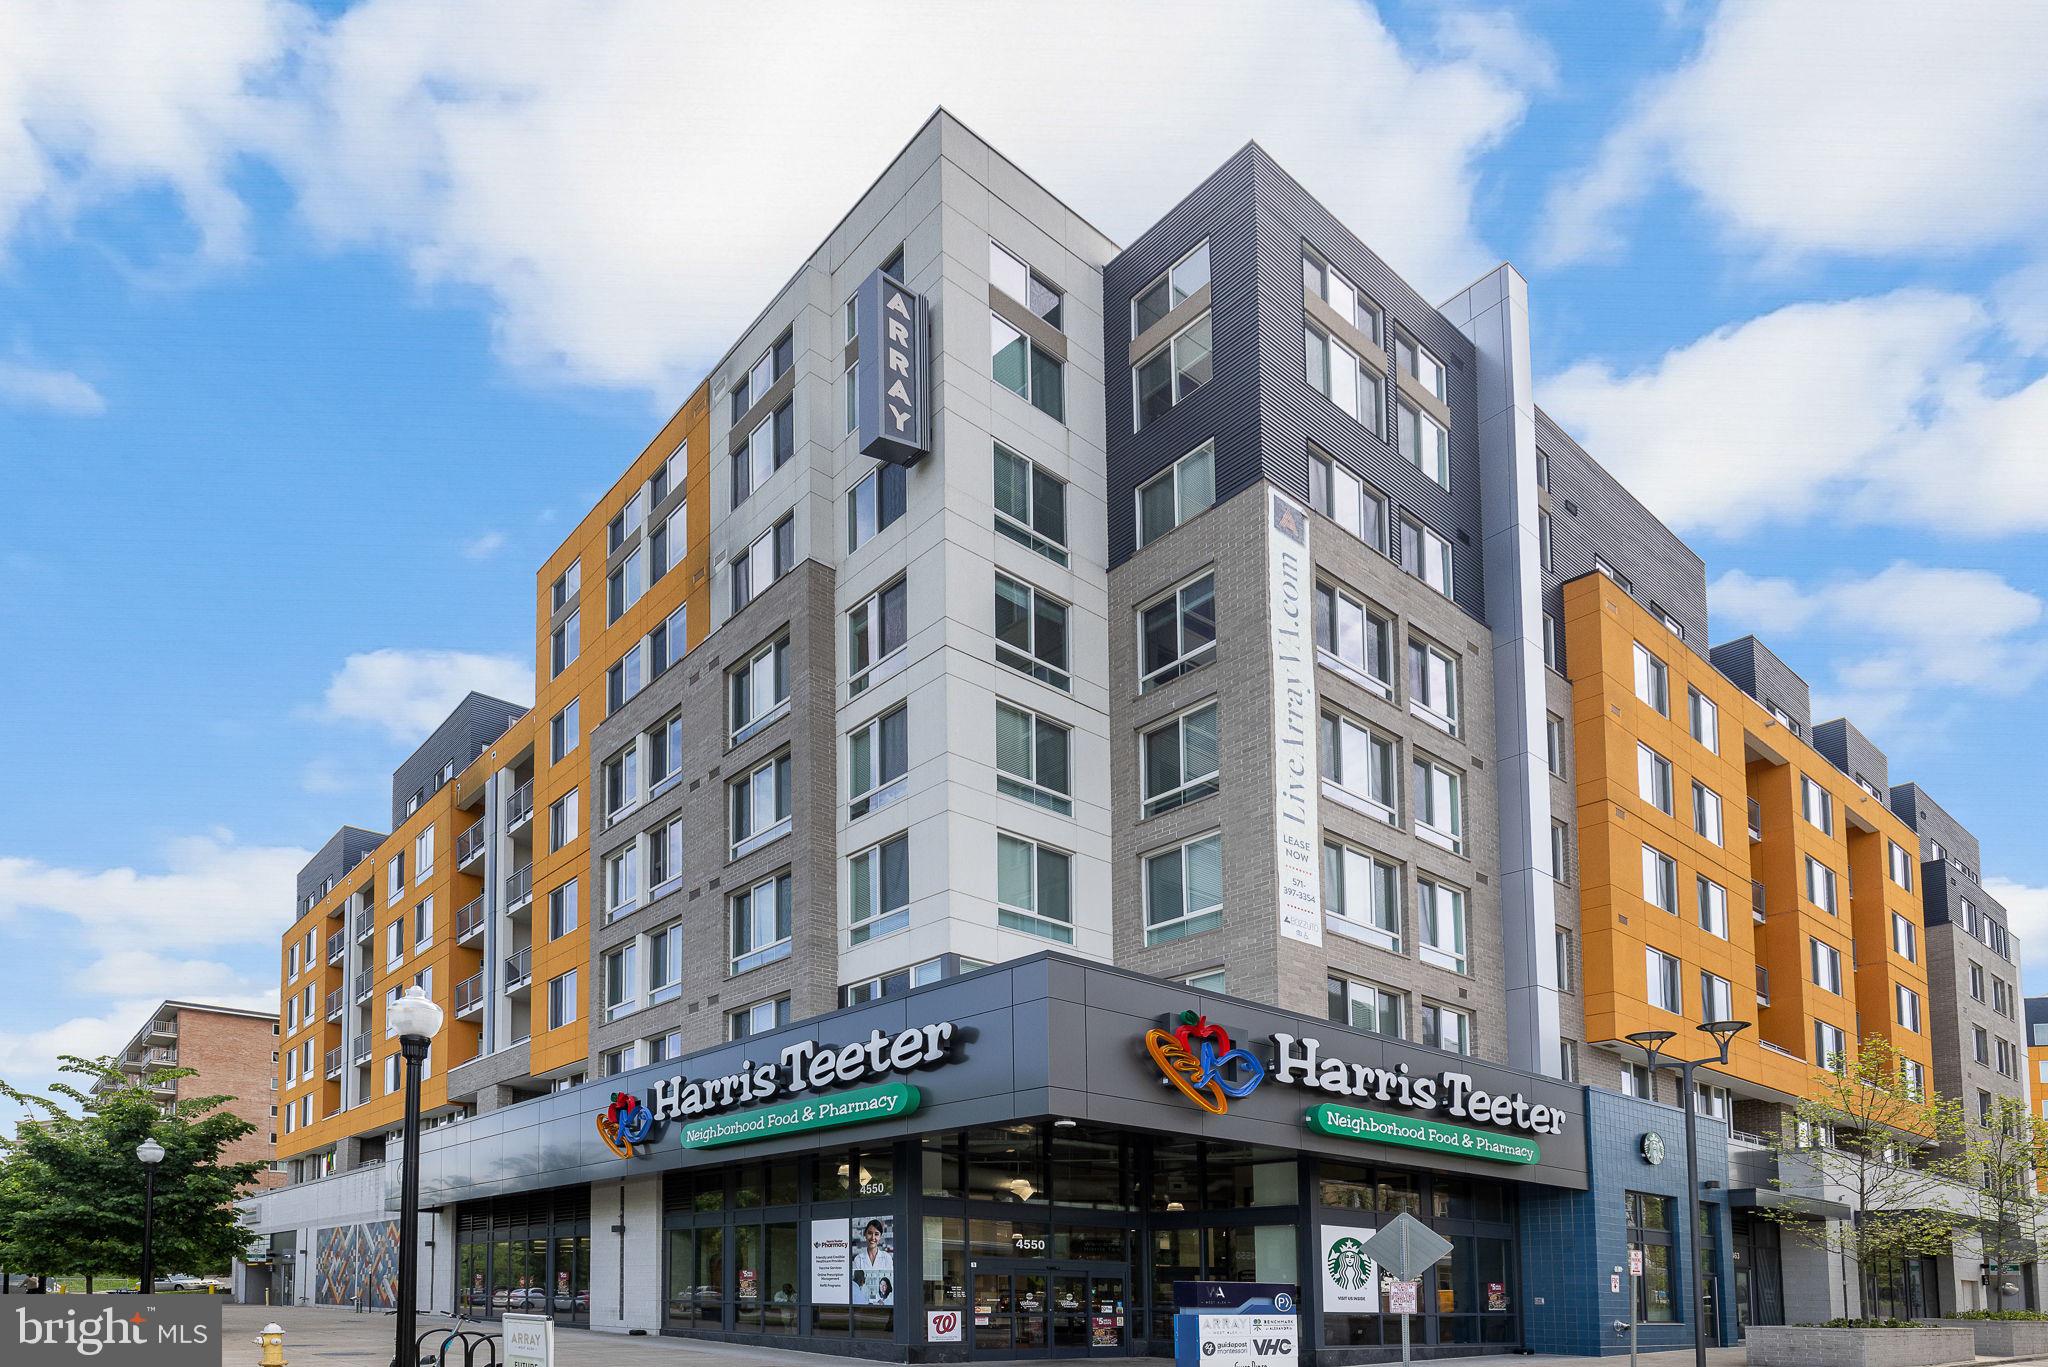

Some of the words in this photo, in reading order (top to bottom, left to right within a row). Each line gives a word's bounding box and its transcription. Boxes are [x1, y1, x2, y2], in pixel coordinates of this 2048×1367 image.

[886, 292, 912, 432] ARRAY
[1283, 834, 1311, 851] LEASE
[1285, 848, 1309, 863] NOW
[653, 1060, 776, 1121] Harris
[780, 1021, 952, 1091] Teeter
[1273, 1033, 1437, 1110] Harris
[1442, 1071, 1566, 1135] Teeter
[686, 1116, 765, 1143] Neighborhood
[767, 1105, 798, 1128] Food
[801, 1106, 816, 1122] &
[818, 1094, 898, 1119] Pharmacy
[1326, 1111, 1425, 1141] Neighborhood
[1428, 1128, 1459, 1147] Food
[1461, 1133, 1473, 1147] &
[1476, 1138, 1535, 1161] Pharmacy
[860, 1182, 884, 1194] 4550
[1015, 1239, 1045, 1250] 4550
[1203, 1318, 1247, 1330] ARRAY
[512, 1332, 541, 1346] ARRAY
[1217, 1341, 1248, 1349] guidepost
[1253, 1339, 1292, 1356] VHC
